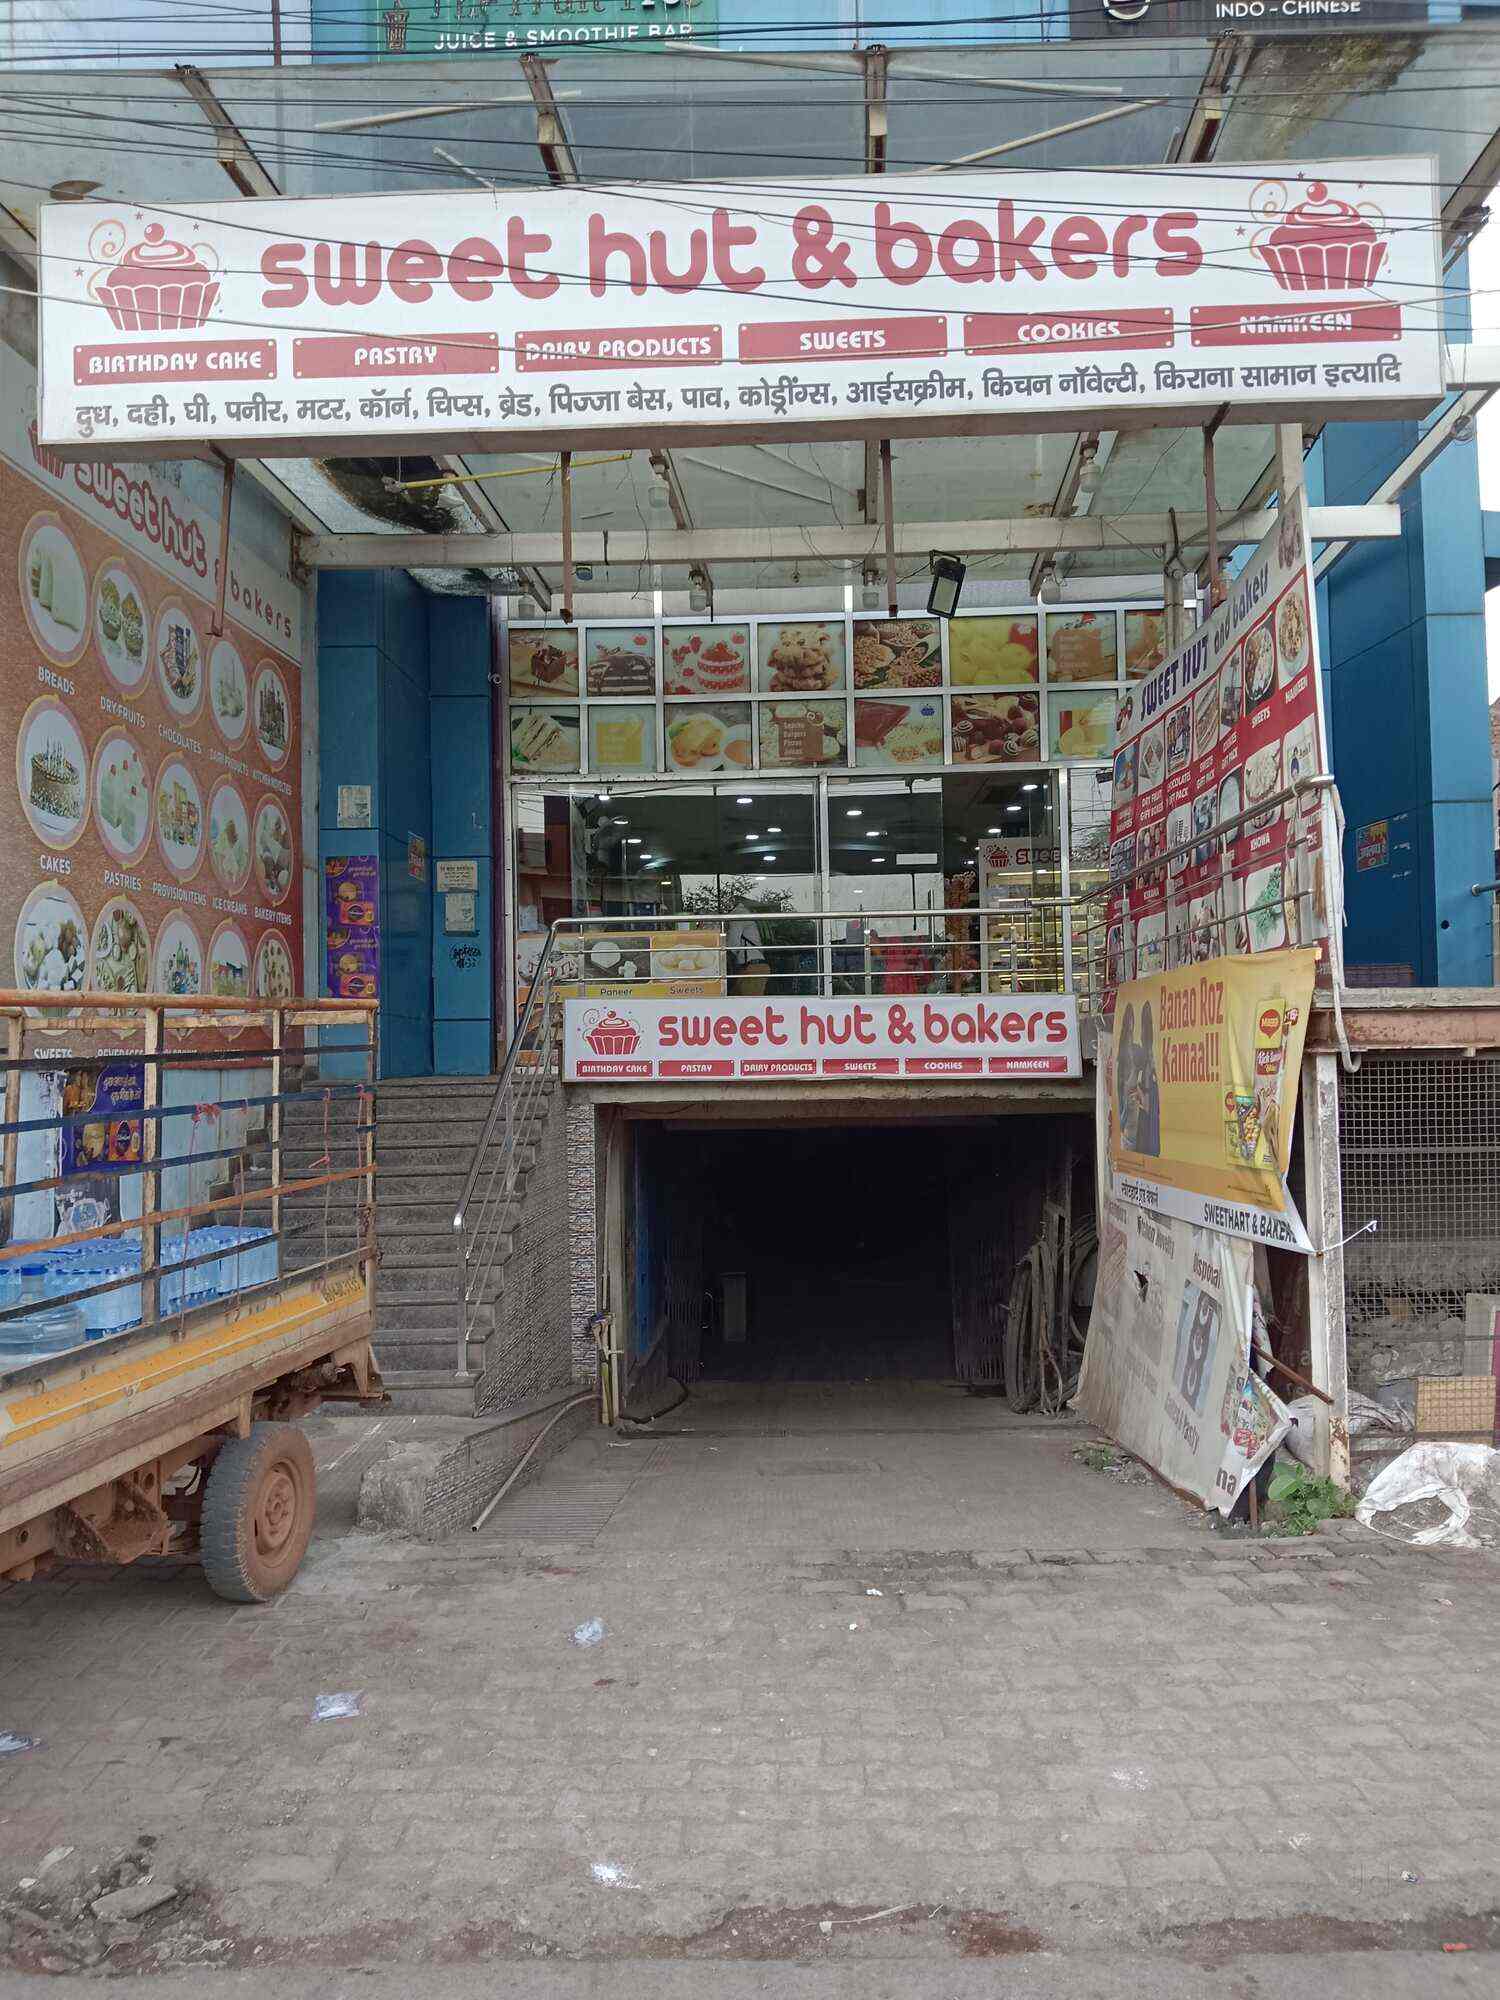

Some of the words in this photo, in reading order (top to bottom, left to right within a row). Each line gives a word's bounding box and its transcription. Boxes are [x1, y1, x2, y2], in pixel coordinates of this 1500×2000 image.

[1215, 1, 1264, 18] INDO
[1284, 0, 1361, 15] CHINESE
[433, 32, 496, 51] JUICE
[505, 31, 518, 47] &
[526, 24, 640, 49] SMOOTHIE
[648, 23, 695, 41] BAR
[261, 214, 561, 309] sweet
[588, 207, 766, 297] hut
[791, 204, 858, 289] &
[875, 199, 1204, 285] bakers
[1017, 320, 1121, 343] COOKIES
[1239, 312, 1353, 335] NAMKEEN
[525, 341, 591, 361] DAIRY
[598, 336, 712, 359] PRODUCTS
[799, 330, 886, 351] SWEETS
[88, 352, 198, 374] BIRTHDAY
[206, 351, 262, 369] CAKE
[354, 344, 438, 367] PASTRY
[126, 394, 176, 427] दही,
[184, 392, 217, 425] घी,
[225, 391, 289, 425] पनीर,
[296, 398, 351, 422] मटर,
[358, 387, 420, 421] कॉर्न,
[426, 386, 491, 418] चिप्स,
[498, 385, 542, 420] ब्रेड,
[549, 383, 621, 414] पिज्जा
[626, 381, 673, 412] बेस,
[680, 386, 731, 410] पाव,
[846, 369, 974, 407] आईसक्रीम,
[981, 367, 1052, 398] किचन
[1058, 361, 1146, 395] नॉवेल्टी,
[1153, 360, 1234, 391] किराना
[1240, 363, 1318, 388] सामान
[1322, 353, 1403, 388] इत्यादि
[74, 461, 160, 544] sweet
[161, 496, 207, 577] hut
[229, 569, 293, 640] bakers
[1140, 658, 1180, 722] SWEET
[1182, 634, 1209, 688] HUT
[1213, 613, 1232, 655] and
[1232, 566, 1269, 628] bakers
[38, 665, 76, 697] BREADS
[158, 723, 202, 755] CHOCOLATES
[40, 854, 71, 875] CAKES
[104, 870, 142, 892] PASTRIES
[152, 882, 187, 902] PROVISION
[600, 988, 633, 997] Paneer
[670, 985, 704, 995] Sweets
[1160, 983, 1197, 1032] Banao
[1200, 976, 1224, 1027] Roz
[657, 1005, 789, 1048] sweet
[800, 1004, 877, 1047] hut
[887, 1003, 917, 1045] &
[923, 1002, 1069, 1044] bakers
[582, 1064, 624, 1074] BIRTHDAY
[625, 1064, 649, 1073] CAKE
[681, 1064, 713, 1073] PASTRY
[744, 1063, 769, 1072] DAIRY
[770, 1062, 813, 1072] PRODUCTS
[843, 1062, 877, 1071] SWEETS
[924, 1061, 963, 1070] COOKIES
[1006, 1060, 1050, 1070] NAMKEEN
[1162, 1031, 1220, 1084] Kamaal!!
[1204, 1202, 1250, 1233] SWEETHART
[1252, 1214, 1259, 1235] &
